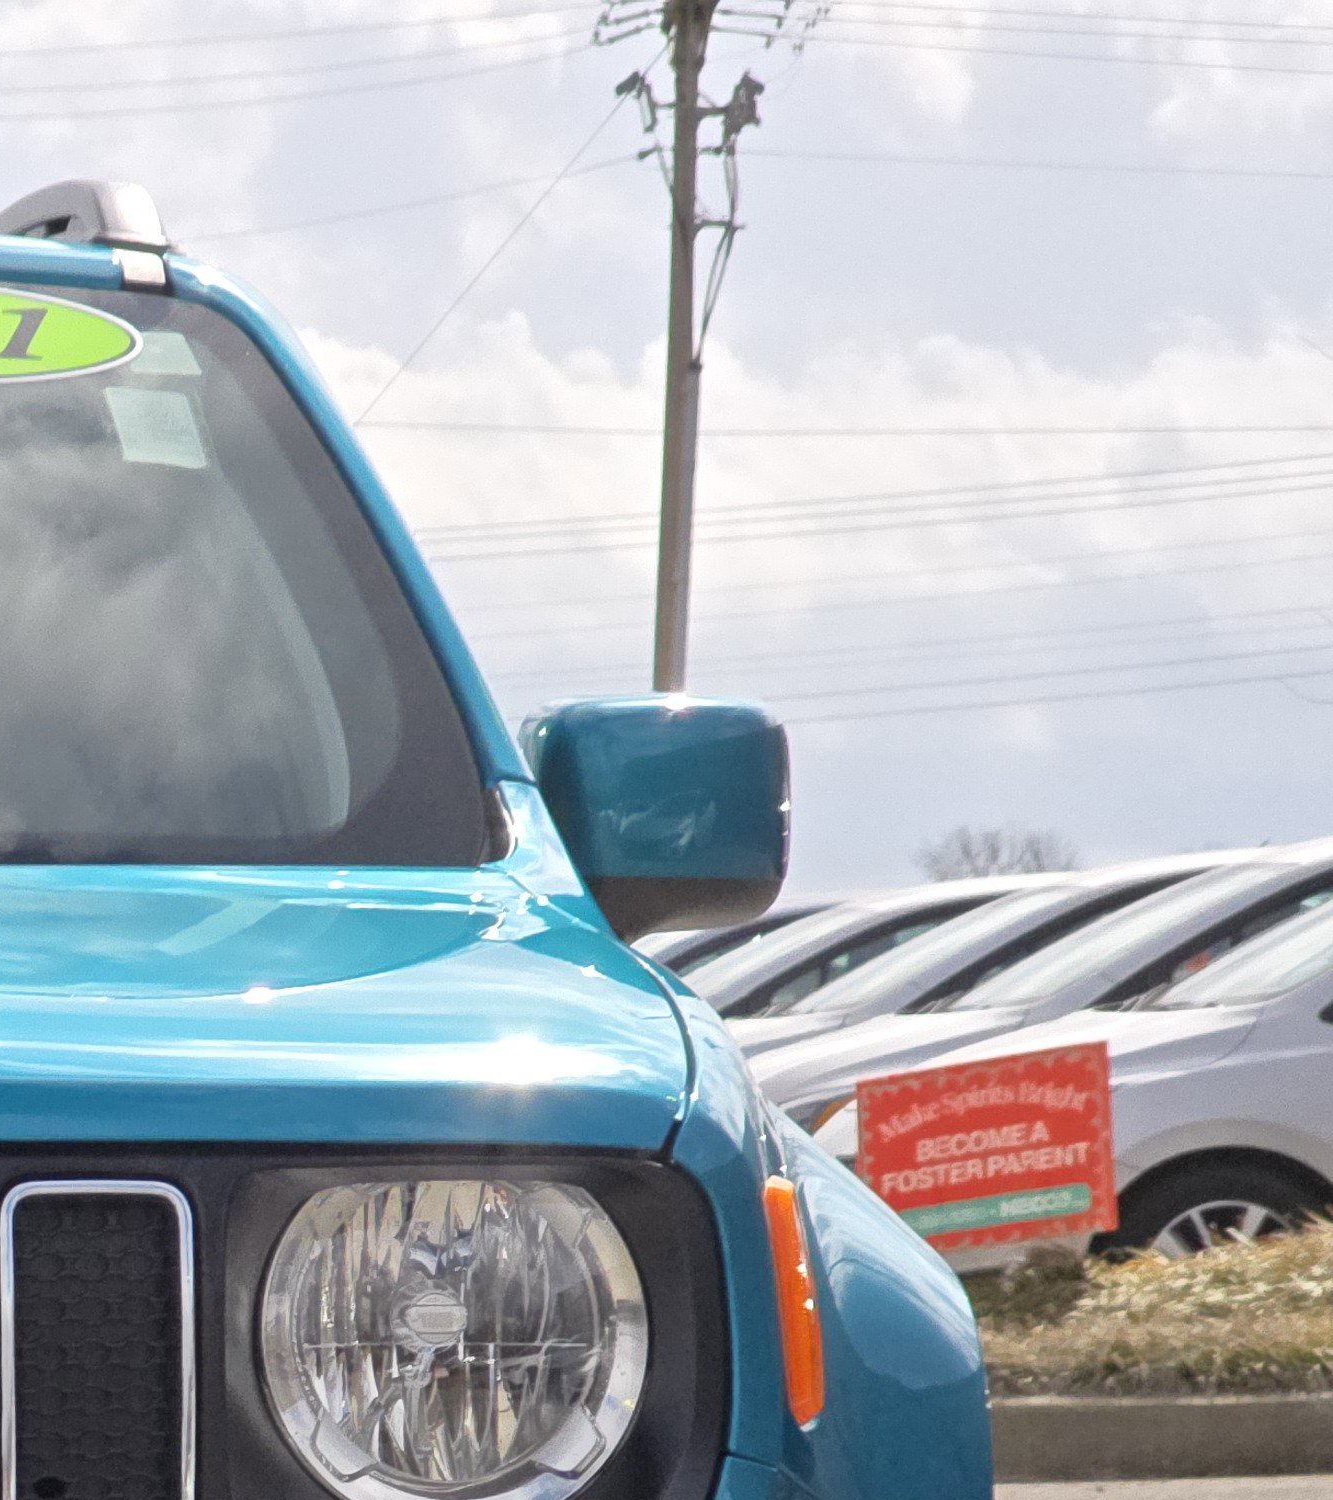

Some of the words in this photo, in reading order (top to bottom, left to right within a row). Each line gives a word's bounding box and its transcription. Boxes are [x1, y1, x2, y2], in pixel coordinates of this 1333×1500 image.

[916, 1123, 1027, 1162] BECOME
[1029, 1120, 1051, 1145] A
[882, 1158, 983, 1195] FOSTER
[987, 1141, 1091, 1178] PARENT
